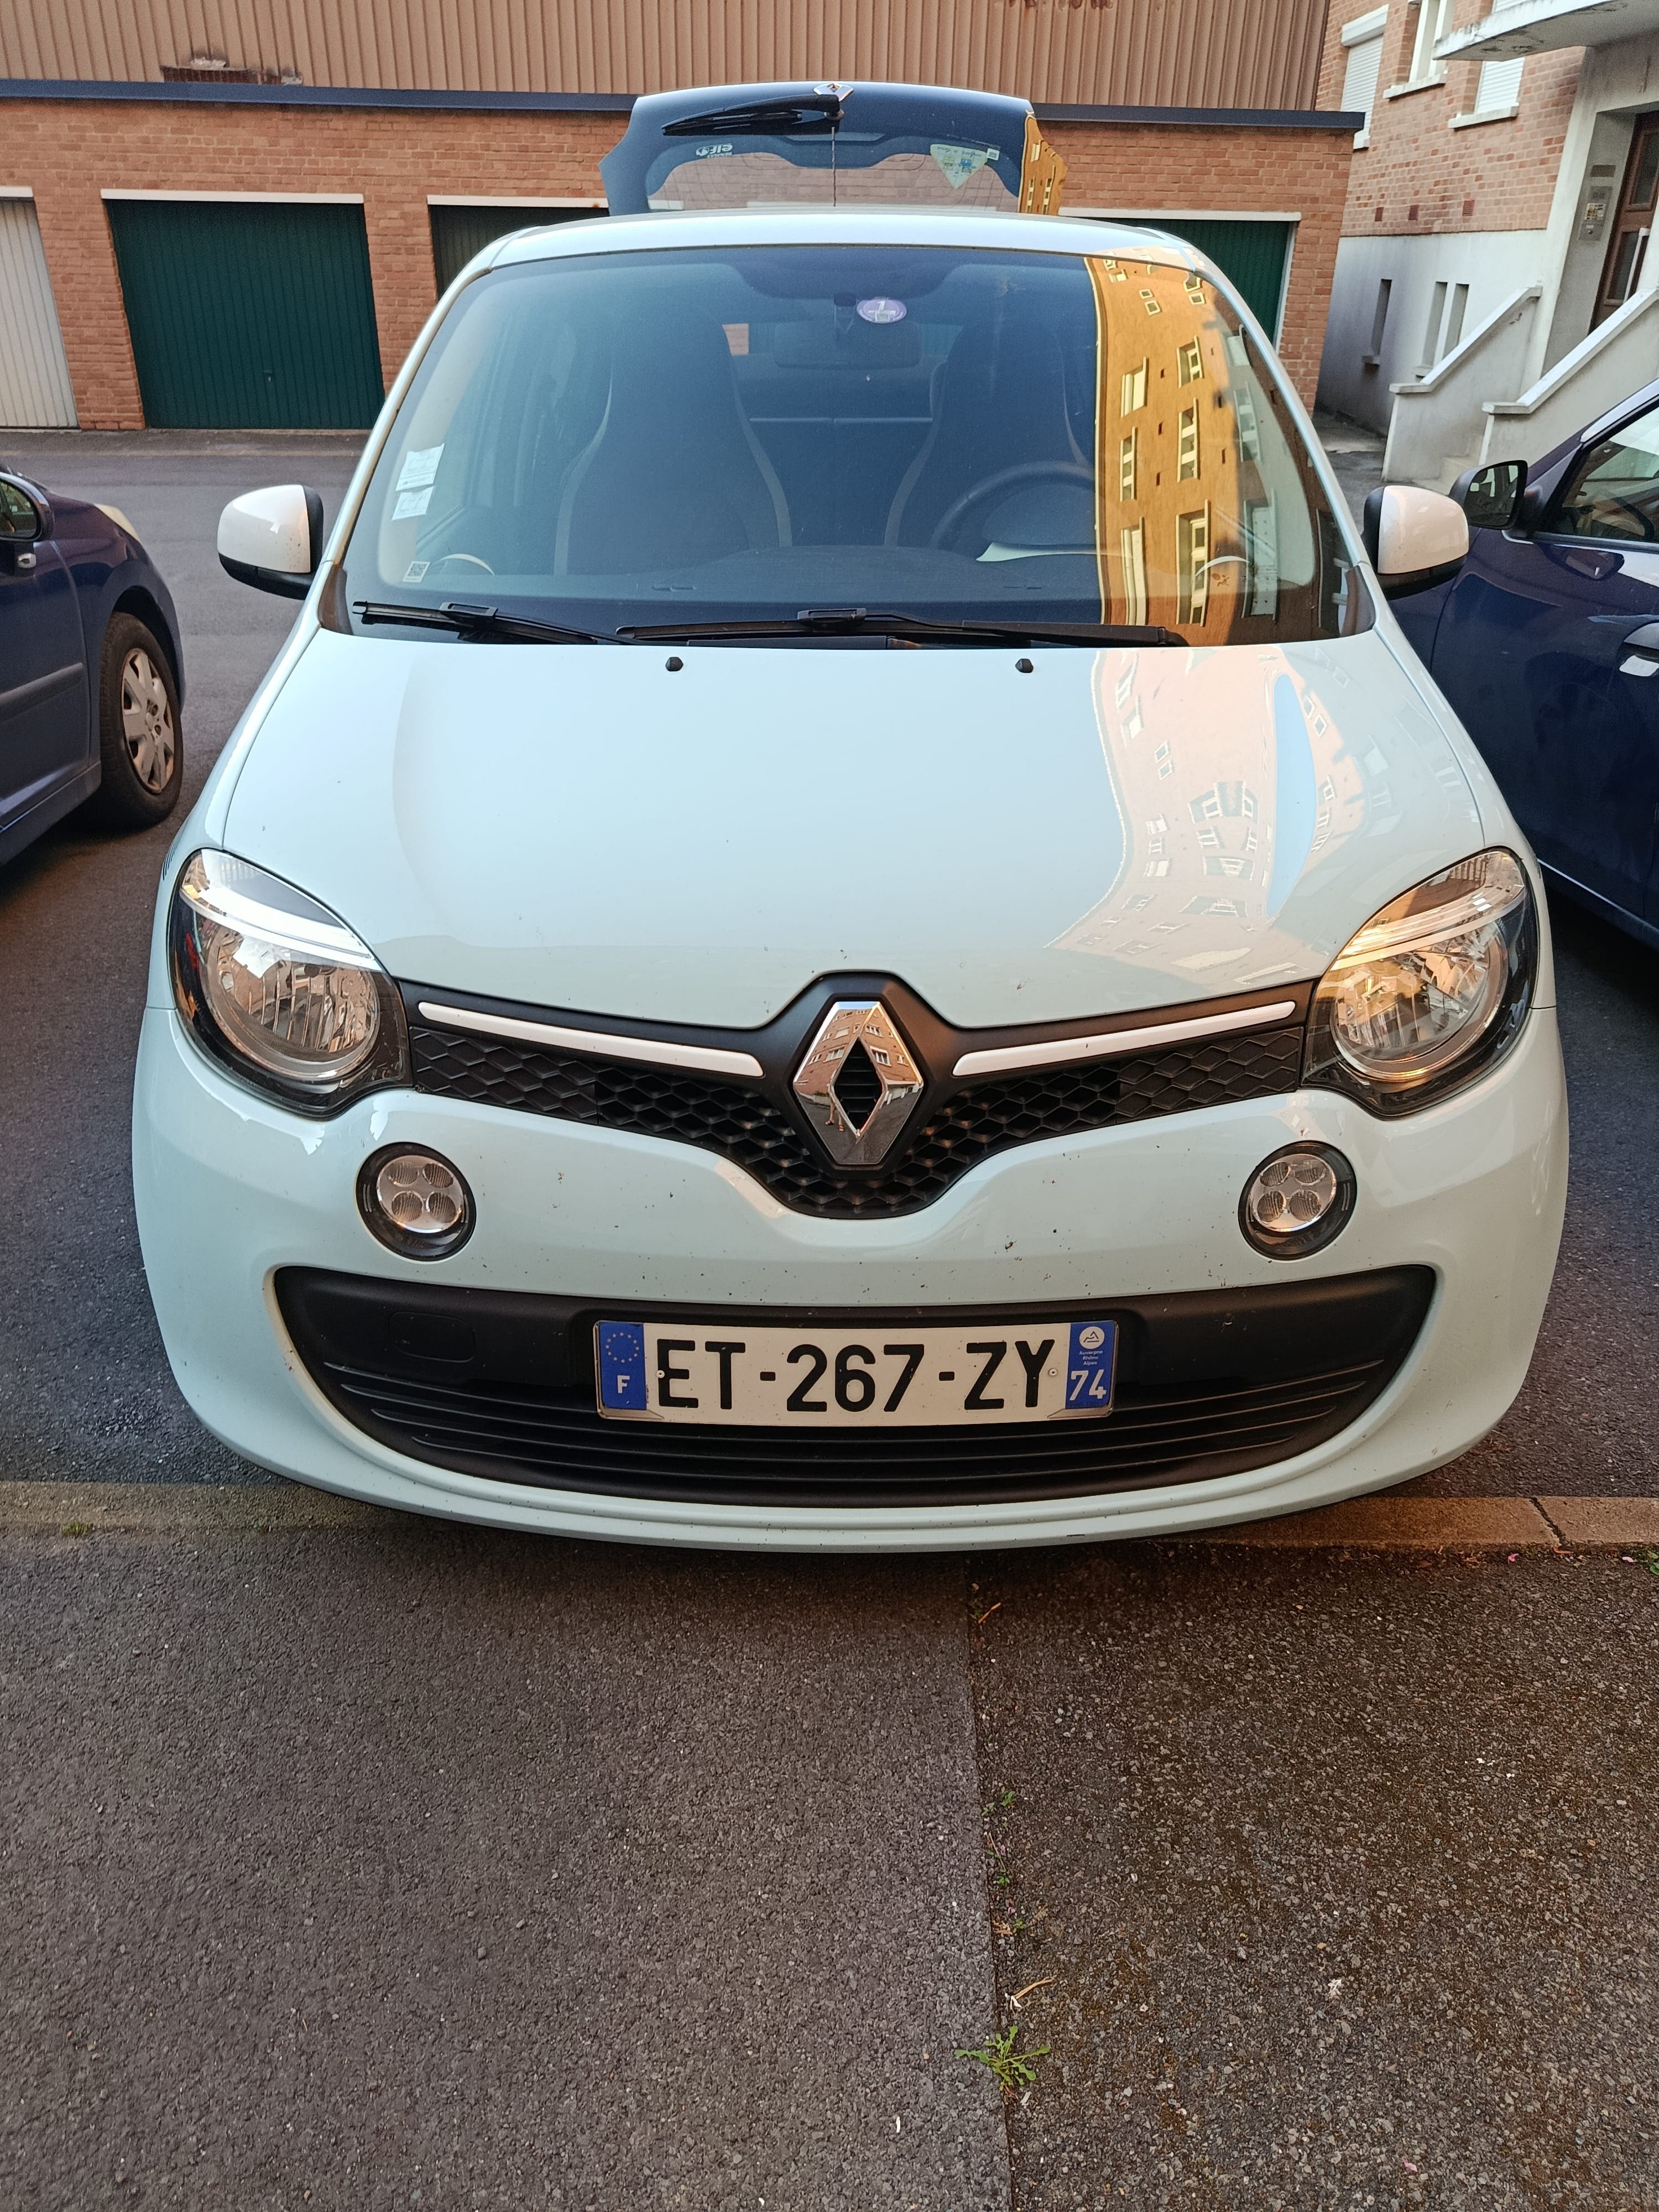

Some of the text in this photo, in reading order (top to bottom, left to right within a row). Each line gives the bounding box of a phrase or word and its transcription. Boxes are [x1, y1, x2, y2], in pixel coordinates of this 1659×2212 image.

[709, 144, 733, 154] elf
[617, 1376, 630, 1393] F
[657, 1339, 1055, 1412] ET-267-ZY
[1070, 1369, 1107, 1401] 74
